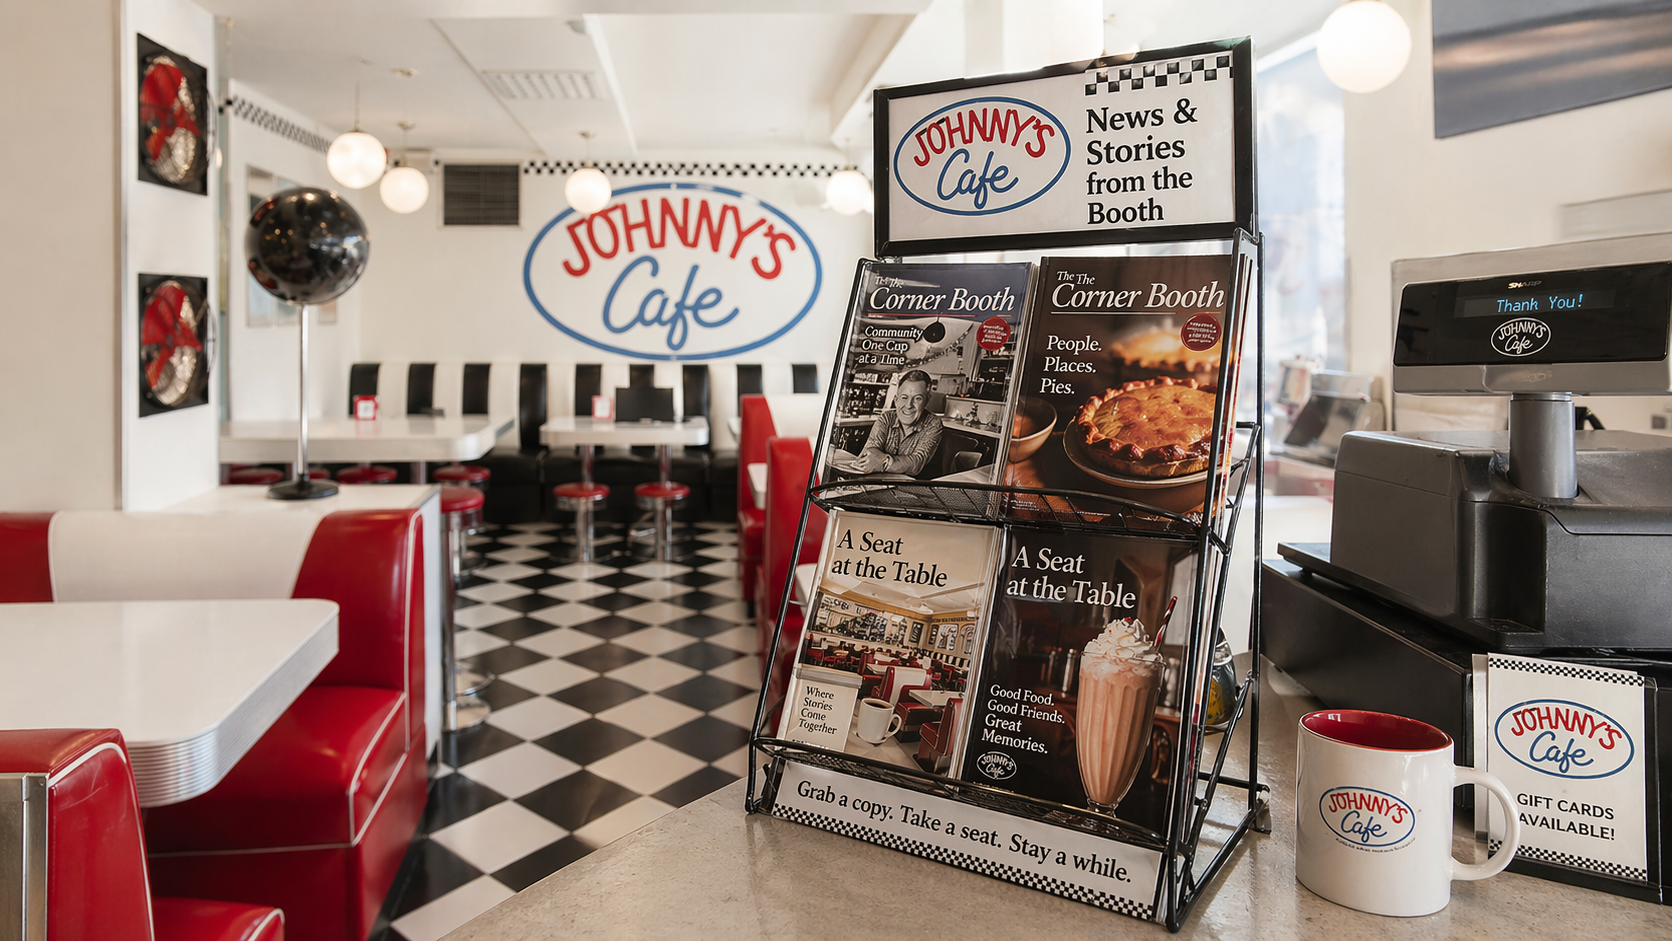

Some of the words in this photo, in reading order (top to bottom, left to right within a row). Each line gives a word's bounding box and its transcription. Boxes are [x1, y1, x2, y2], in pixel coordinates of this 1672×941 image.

[1086, 106, 1164, 134] News
[1174, 98, 1198, 124] &
[913, 107, 1056, 166] JOHNNY'S
[1086, 134, 1186, 166] Stories
[936, 148, 1019, 210] Cafe
[1086, 170, 1146, 196] from
[1153, 166, 1193, 191] the
[1087, 198, 1165, 225] Booth
[562, 197, 796, 280] JOHNNY'S
[1056, 271, 1075, 281] The
[1076, 273, 1096, 285] The
[602, 255, 740, 351] Cafe
[870, 286, 946, 310] Corner
[948, 286, 1015, 311] Booth
[1052, 282, 1142, 308] Corner
[1144, 280, 1225, 308] Booth
[1496, 297, 1538, 313] Thank
[1549, 294, 1584, 310] You!
[864, 325, 924, 340] Community
[1046, 334, 1102, 356] People.
[1504, 334, 1533, 354] Cafe
[858, 354, 870, 364] at
[870, 356, 877, 364] a
[880, 354, 905, 365] Time
[862, 340, 884, 350] One
[886, 340, 908, 354] Cup
[1043, 356, 1097, 373] Places.
[1039, 378, 1076, 395] Pies.
[837, 529, 855, 550] A
[860, 534, 904, 556] Seat
[831, 558, 850, 576] at
[854, 556, 886, 580] the
[892, 560, 948, 588] Table
[1012, 546, 1030, 568] A
[1036, 548, 1086, 575] Seat
[1006, 578, 1028, 597] at
[1031, 576, 1067, 602] the
[1072, 580, 1136, 610] Table
[806, 686, 834, 700] Where
[990, 684, 1022, 700] Good
[1022, 690, 1055, 706] Food.
[800, 708, 826, 720] Come
[985, 713, 1022, 732] Great
[987, 699, 1018, 715] Good
[1020, 704, 1066, 724] Friends.
[799, 718, 838, 734] Together
[1510, 706, 1623, 750] JOHNNY'S
[982, 728, 1048, 754] Memories.
[1528, 730, 1594, 774] Cafe
[1328, 792, 1408, 824] JOHNNY'S
[1516, 792, 1554, 810] GIFT
[1557, 800, 1614, 820] CARDS
[796, 780, 836, 806] Grab
[838, 793, 848, 807] a
[852, 795, 894, 821] copy.
[900, 804, 942, 832] Take
[944, 822, 956, 836] a
[960, 824, 1003, 849] seat.
[1008, 832, 1052, 865] Stay
[1054, 850, 1067, 866] a
[1072, 852, 1132, 884] while.
[1340, 810, 1388, 843] Cafe
[1519, 812, 1616, 841] AVAILABLE!
